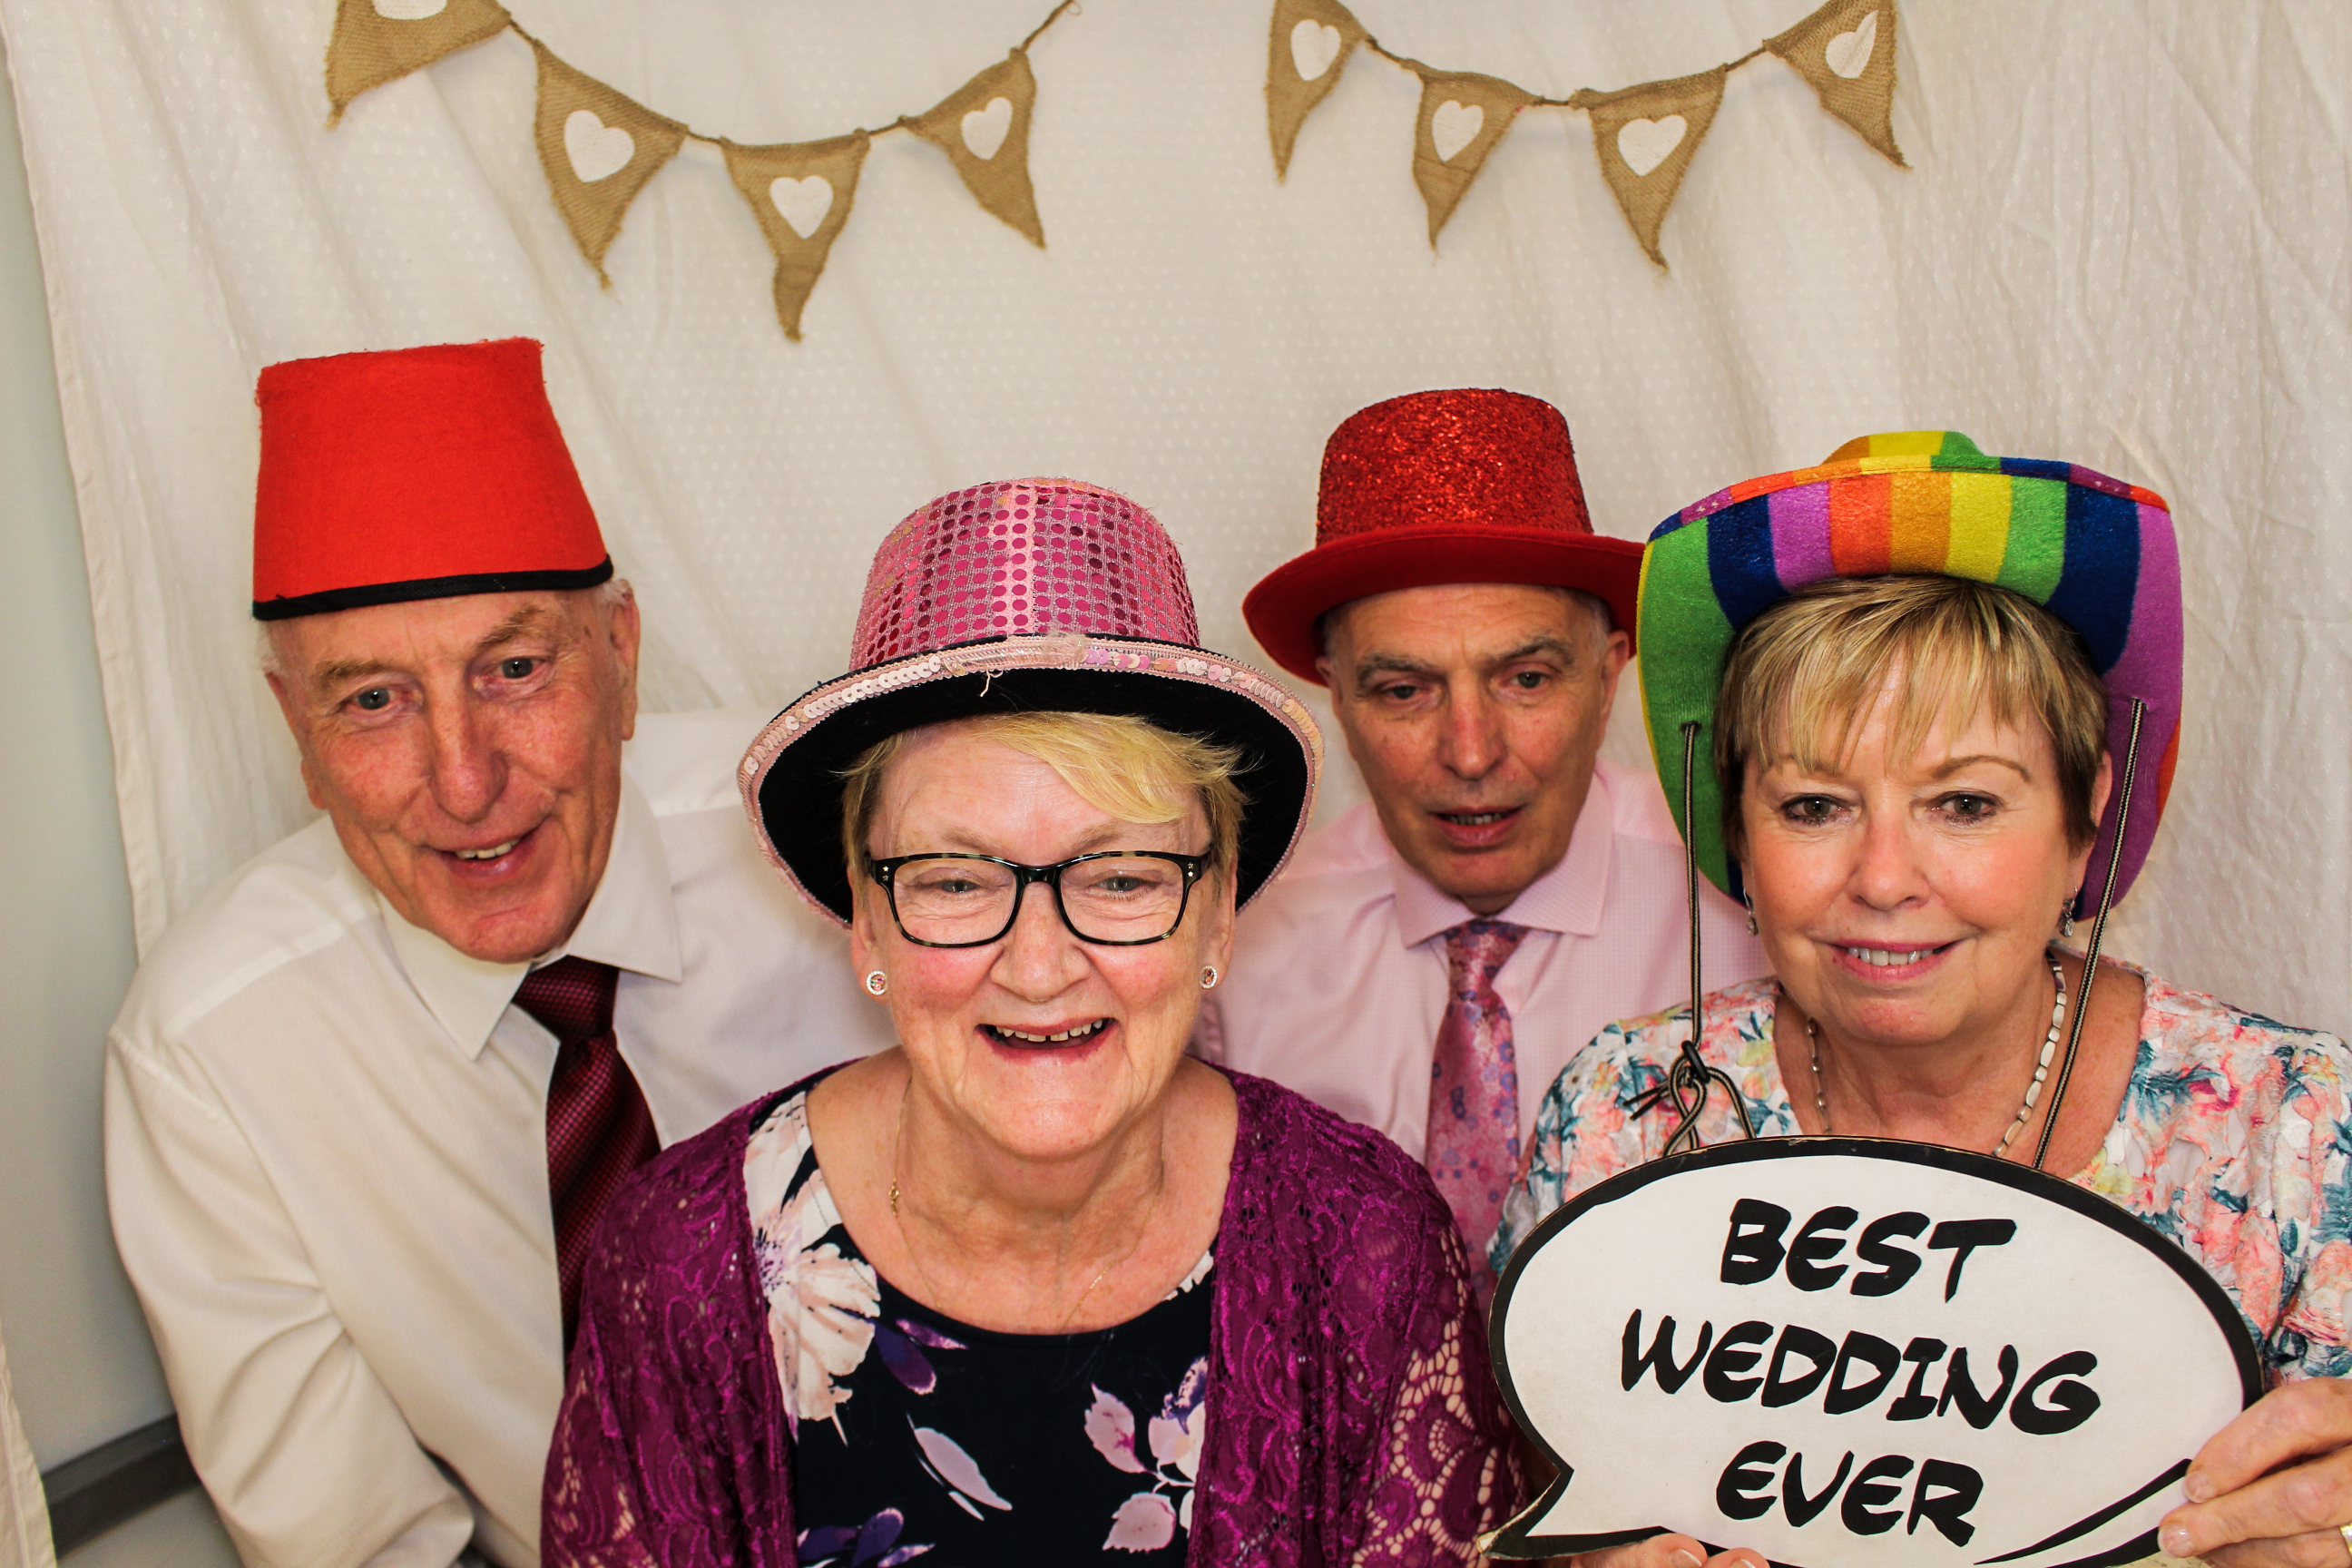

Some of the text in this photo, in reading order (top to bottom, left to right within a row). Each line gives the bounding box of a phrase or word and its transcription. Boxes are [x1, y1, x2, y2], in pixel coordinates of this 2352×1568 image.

[1720, 1198, 2017, 1303] BEST
[1621, 1308, 2102, 1436] WEDDING
[1716, 1440, 1984, 1548] EVER
